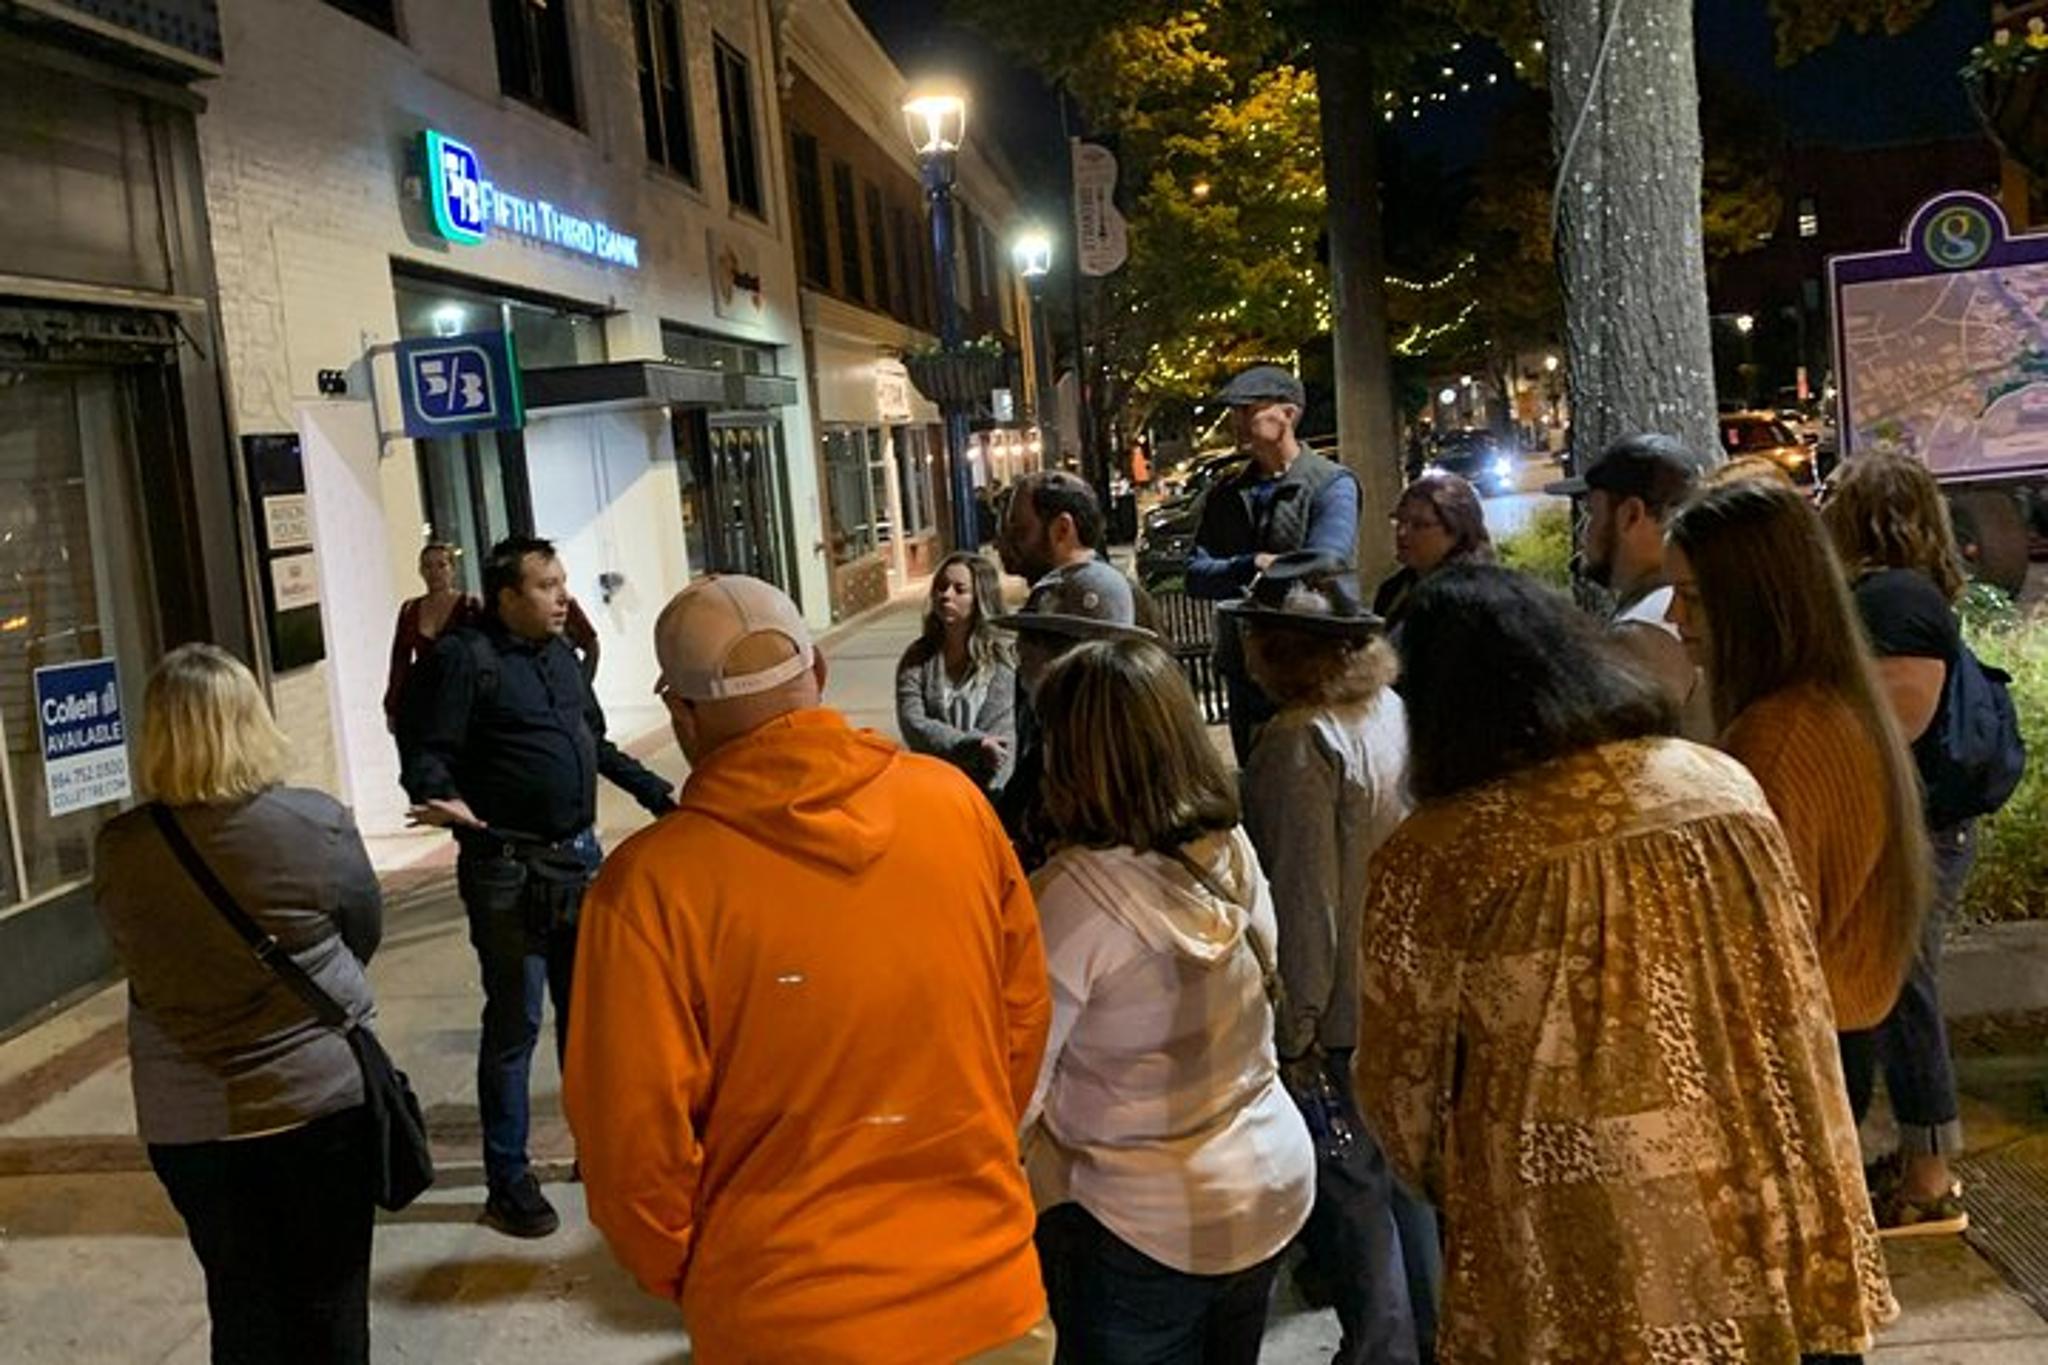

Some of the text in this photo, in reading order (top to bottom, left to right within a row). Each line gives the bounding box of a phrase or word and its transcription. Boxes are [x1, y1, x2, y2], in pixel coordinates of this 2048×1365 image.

[420, 355, 485, 412] 5/3
[42, 690, 98, 726] Collett
[47, 720, 122, 753] AVAILABLE
